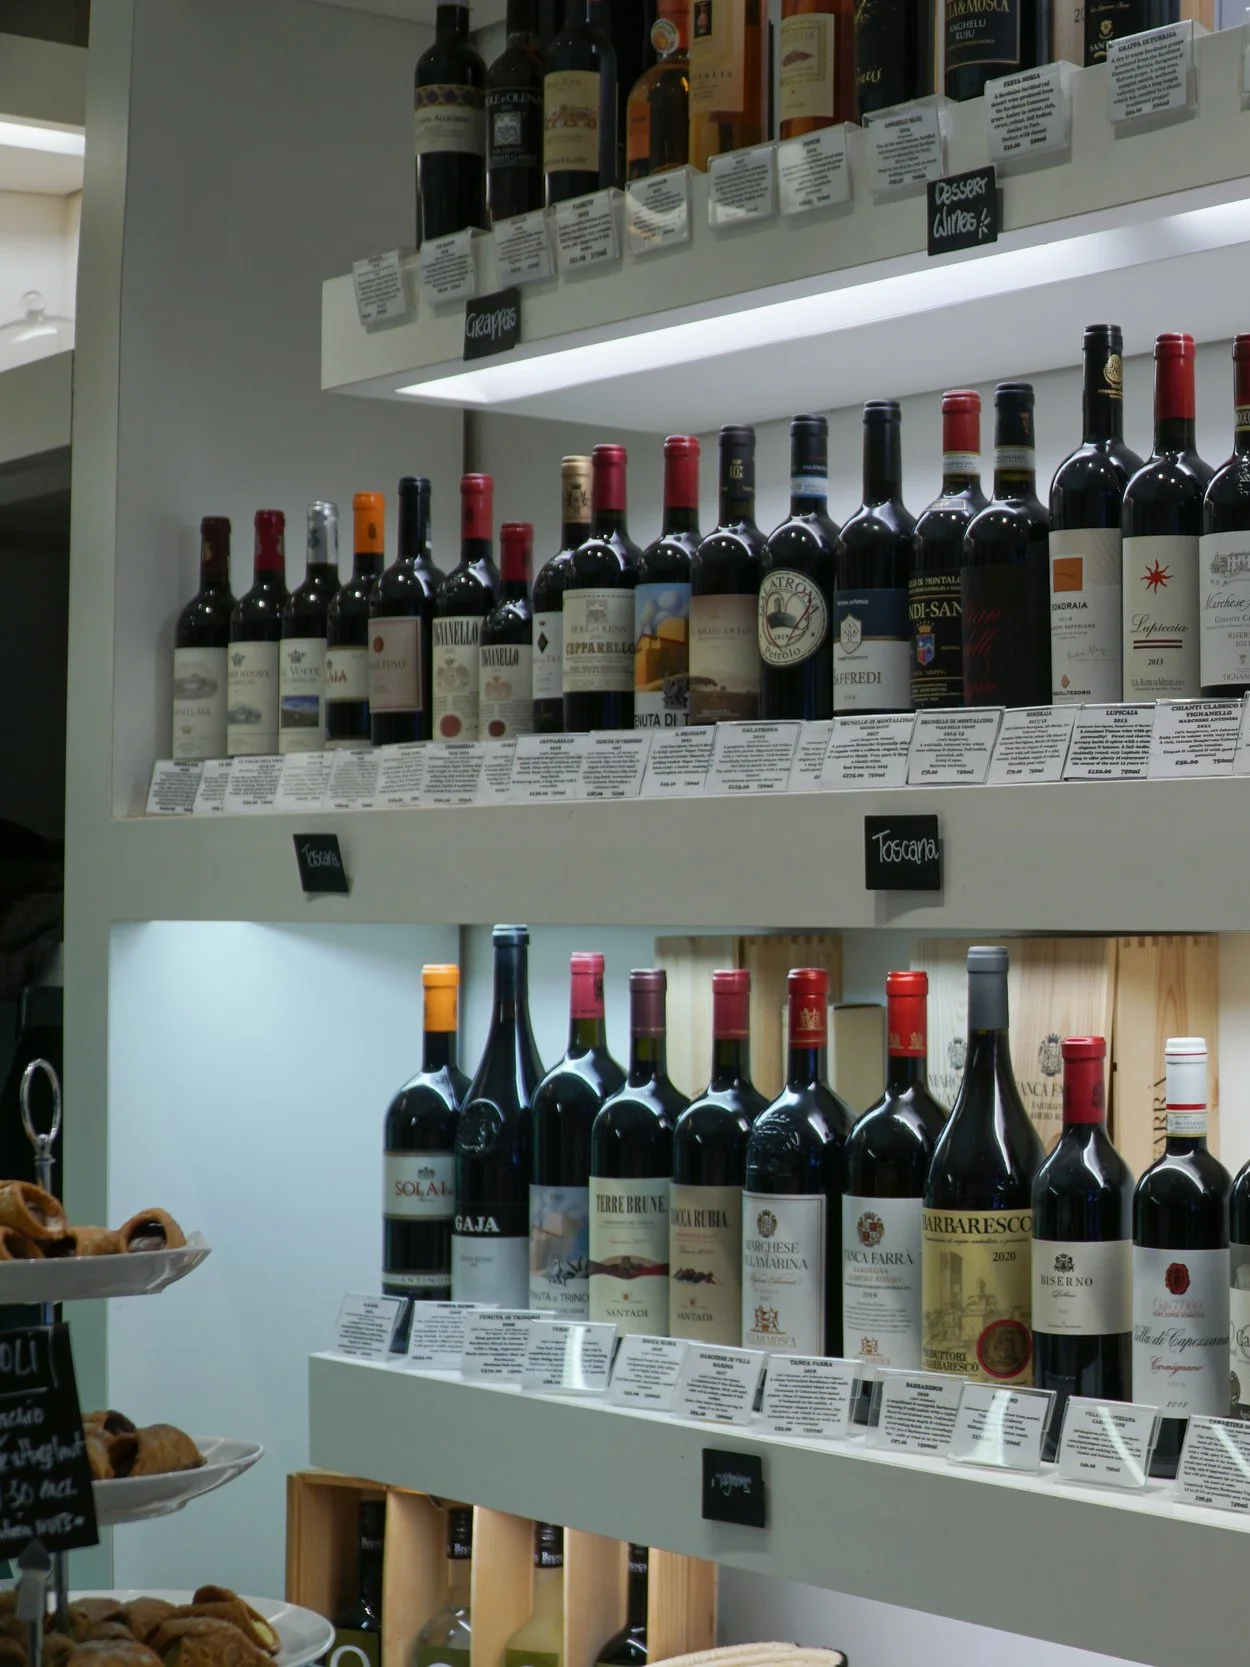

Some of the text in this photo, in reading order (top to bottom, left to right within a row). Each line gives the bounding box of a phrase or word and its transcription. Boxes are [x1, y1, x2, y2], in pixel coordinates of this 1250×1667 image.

[1130, 612, 1189, 638] Lupicaia
[1214, 614, 1241, 623] CHIANTI
[764, 647, 800, 660] Petrolo
[1147, 658, 1164, 666] 2013
[664, 712, 677, 727] DI
[872, 829, 939, 864] Toscana
[596, 1193, 665, 1214] TERRE BRUNE
[455, 1214, 500, 1233] GAJA
[693, 1208, 728, 1228] RUBIA
[871, 1248, 914, 1265] FARRÀ
[992, 1251, 1016, 1262] 2020
[1040, 1275, 1093, 1287] BISERNO
[606, 1308, 649, 1318] SANTADI
[676, 1312, 713, 1322] SANTADI
